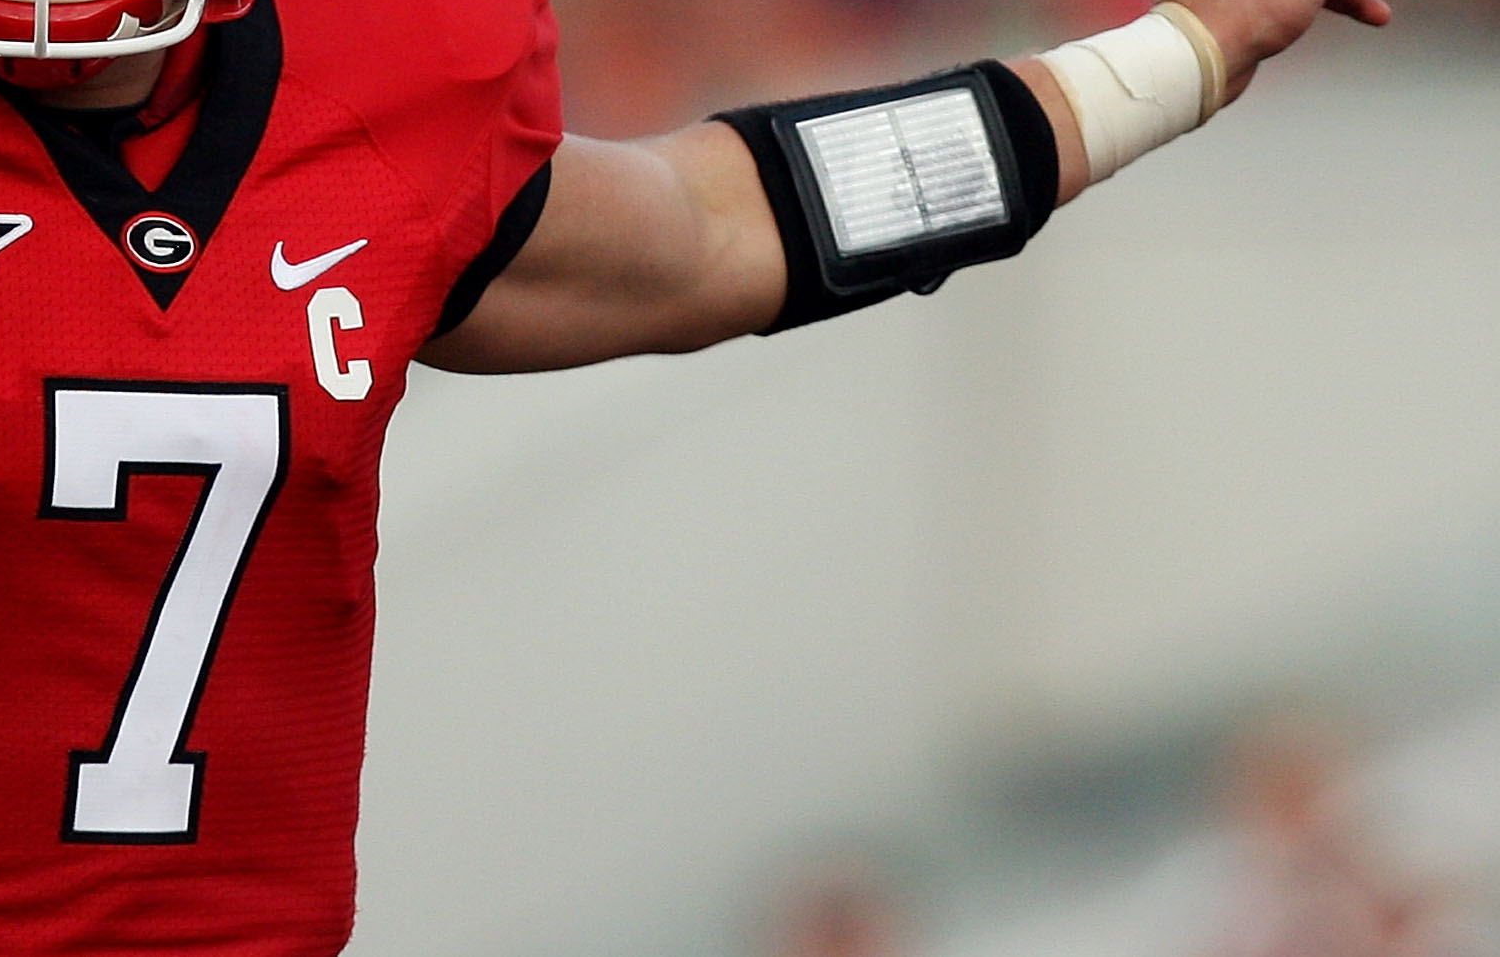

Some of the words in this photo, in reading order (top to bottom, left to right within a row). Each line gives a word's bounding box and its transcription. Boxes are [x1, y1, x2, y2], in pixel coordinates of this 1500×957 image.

[127, 217, 194, 267] G
[307, 286, 373, 401] C
[38, 377, 290, 845] 7
